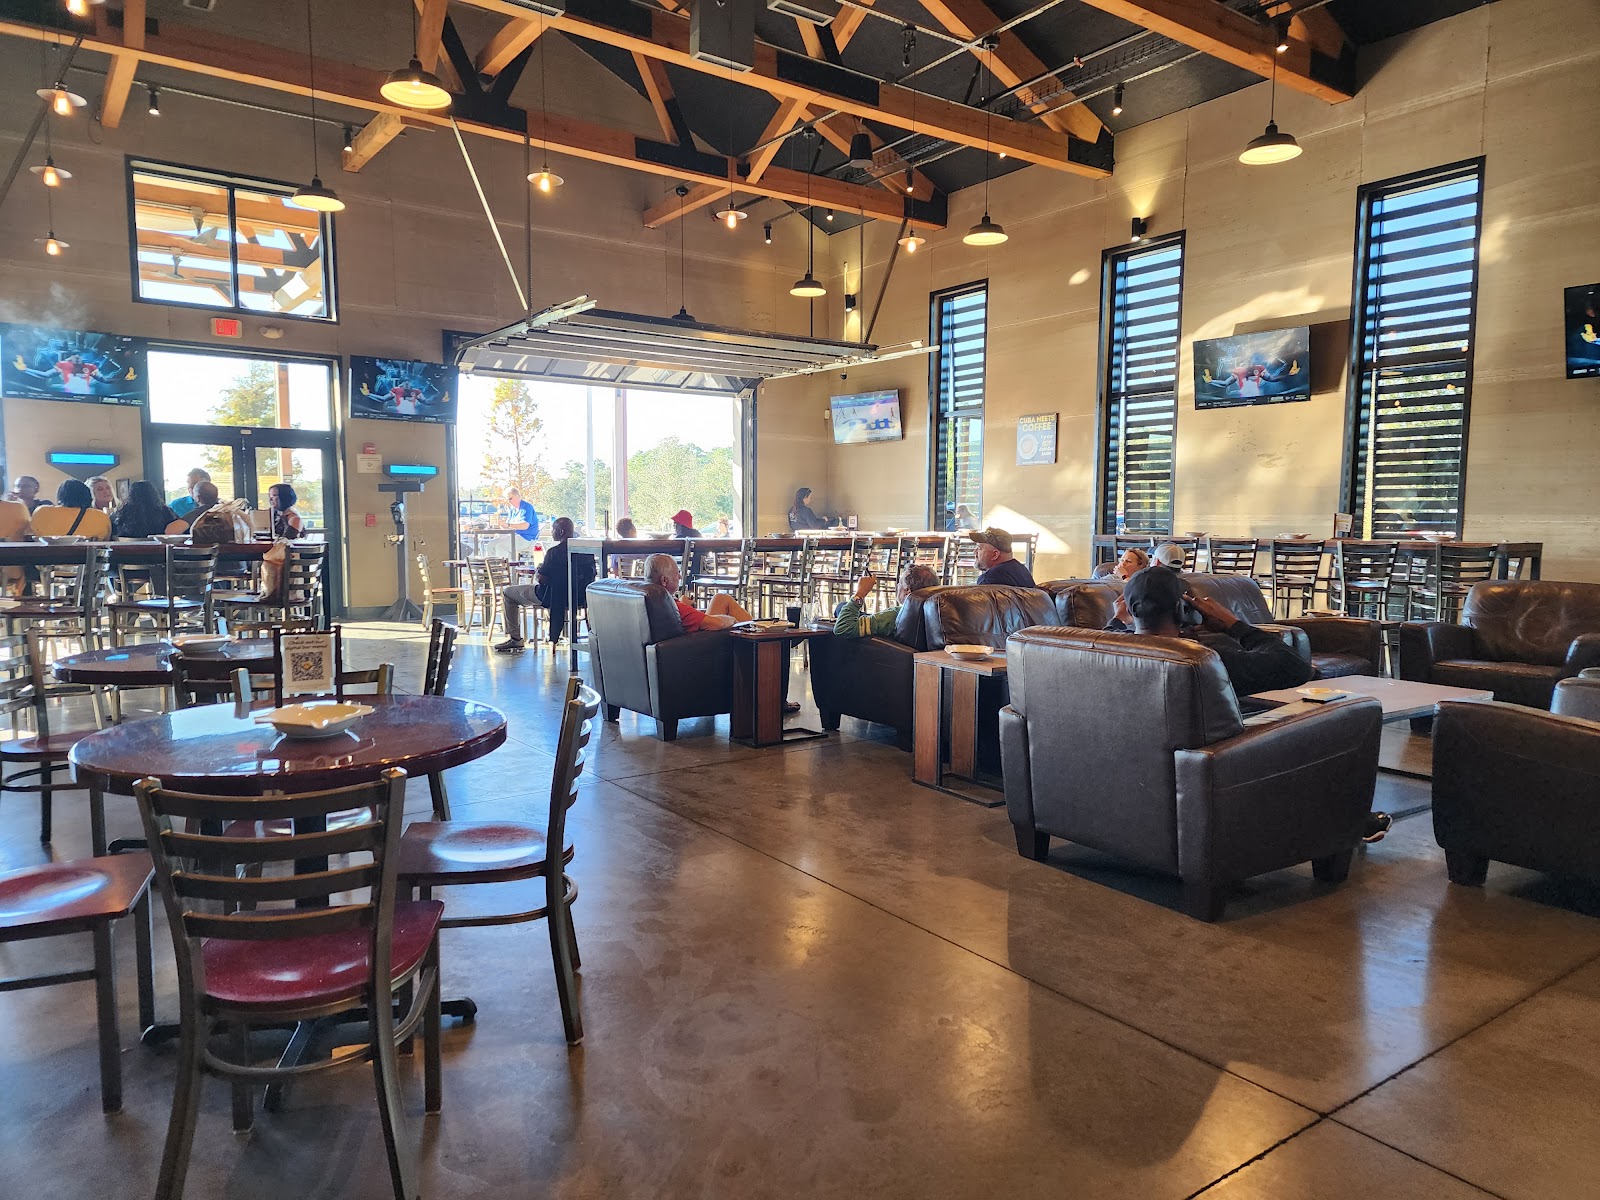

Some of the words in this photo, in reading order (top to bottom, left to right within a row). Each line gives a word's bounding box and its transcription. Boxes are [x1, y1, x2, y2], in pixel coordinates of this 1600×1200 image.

[1019, 416, 1035, 424] CUBA
[1036, 415, 1055, 423] MEETS
[1022, 422, 1051, 432] COFFEE
